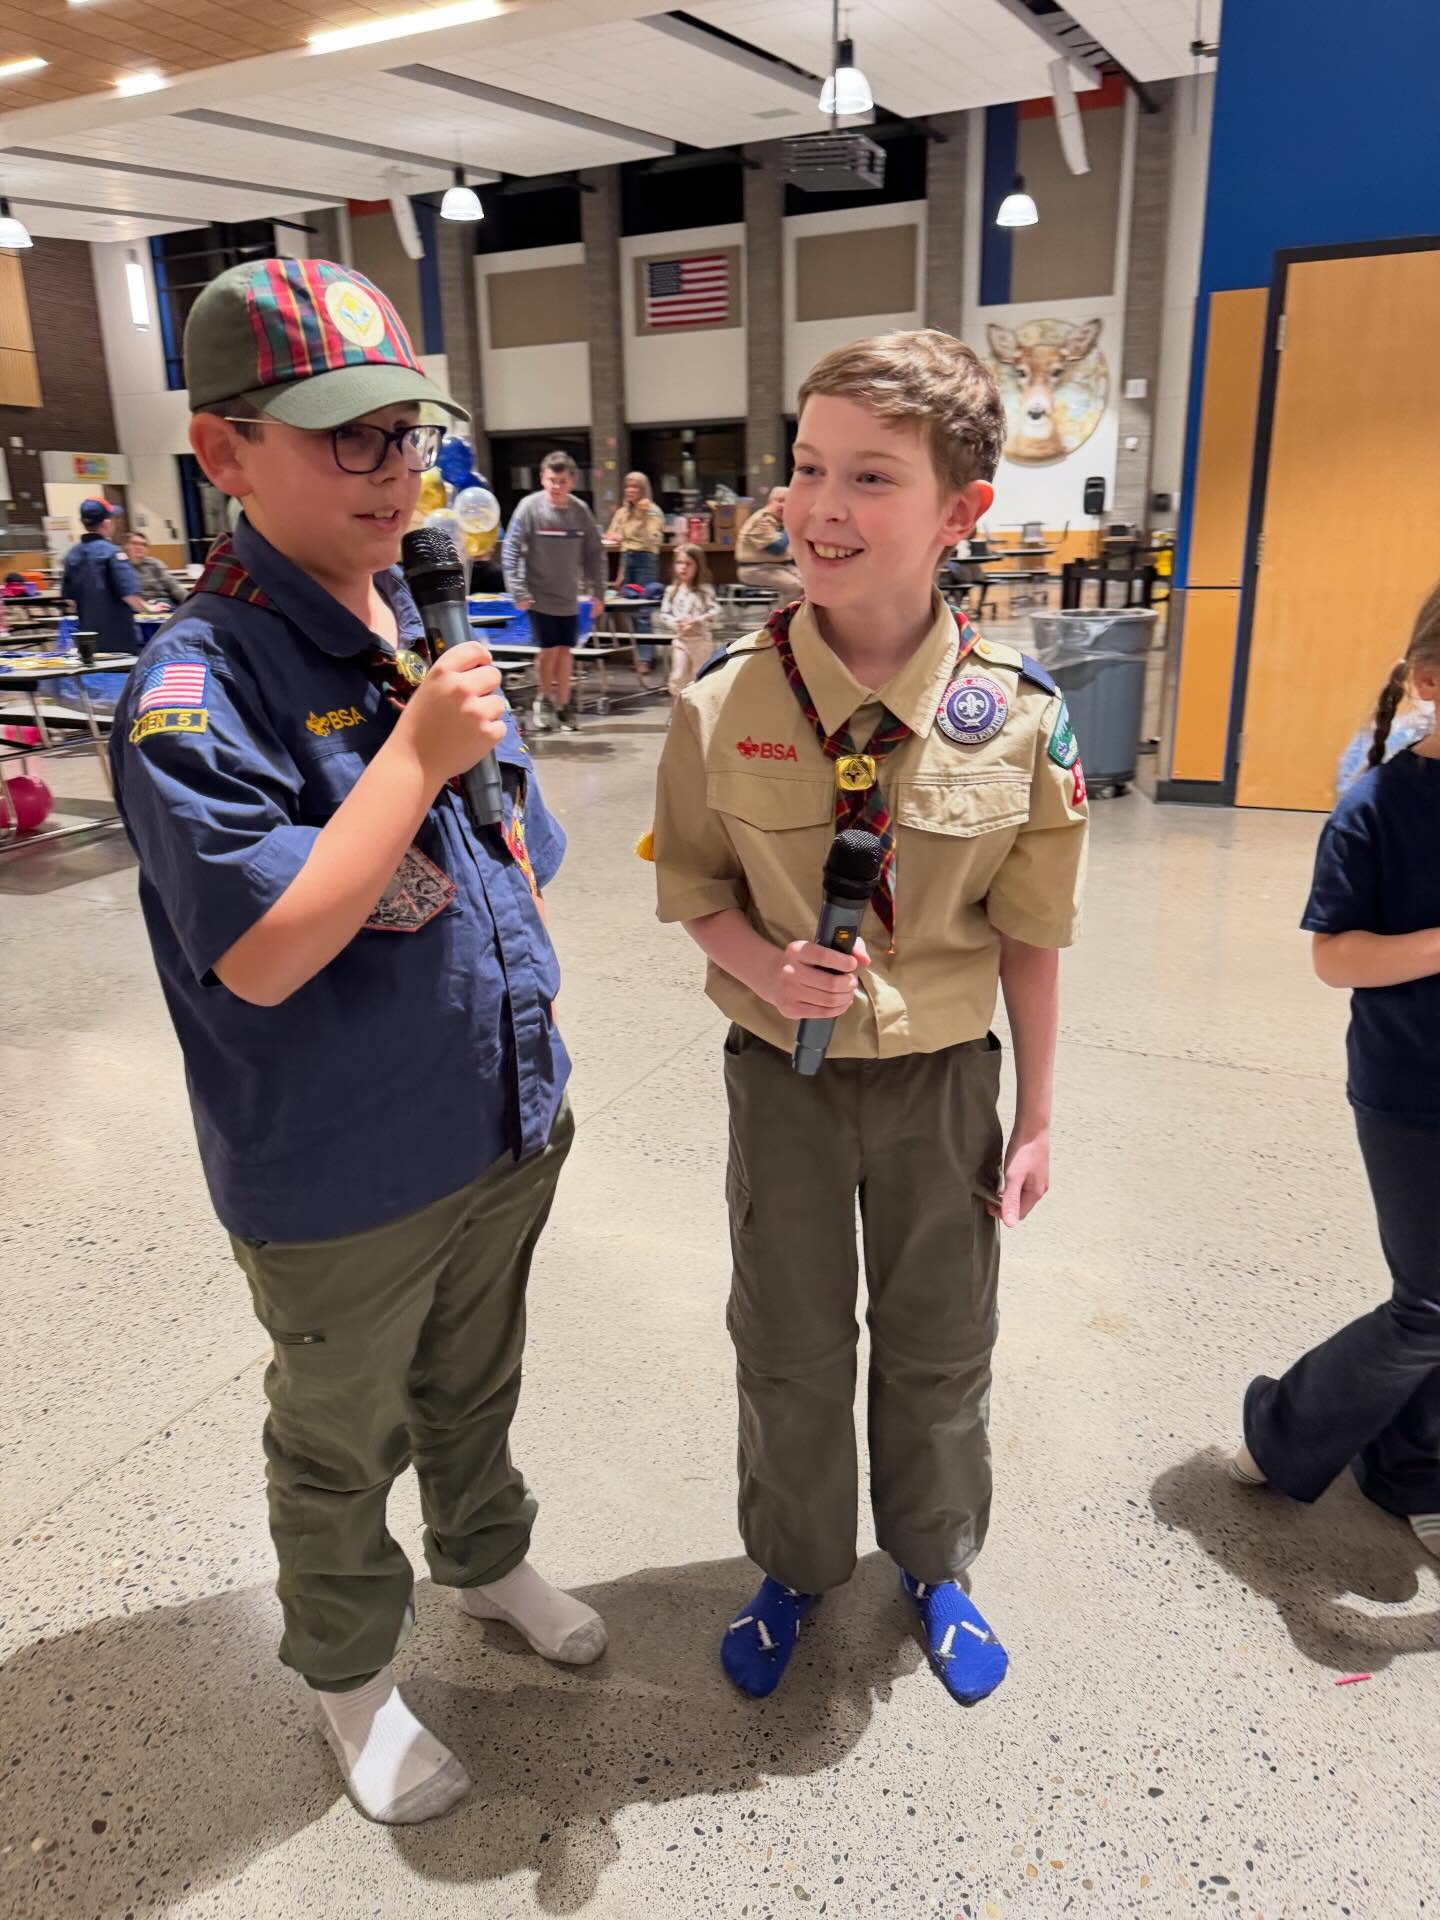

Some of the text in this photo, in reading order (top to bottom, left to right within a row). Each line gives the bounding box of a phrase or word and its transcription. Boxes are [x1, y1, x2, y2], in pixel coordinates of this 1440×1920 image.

[141, 713, 192, 730] DEN 5
[327, 707, 368, 729] BSA
[756, 742, 798, 762] BSA
